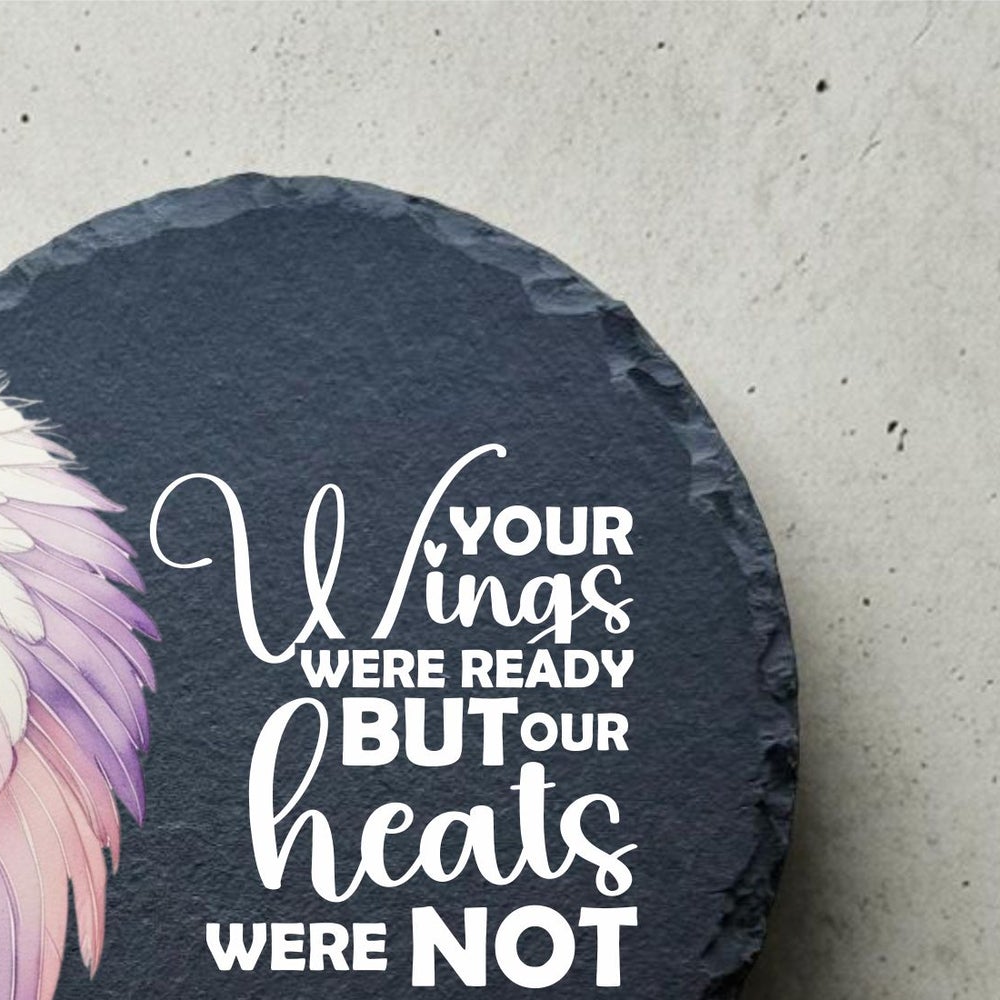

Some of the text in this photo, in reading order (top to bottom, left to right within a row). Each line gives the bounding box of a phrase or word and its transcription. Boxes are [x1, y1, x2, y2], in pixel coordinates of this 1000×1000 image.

[149, 443, 635, 664] Wings
[449, 504, 634, 557] YOUR
[300, 648, 635, 689] WERE READY
[342, 696, 630, 767] BUT OUR
[248, 697, 638, 903] heats
[205, 904, 638, 989] WERE NOT
